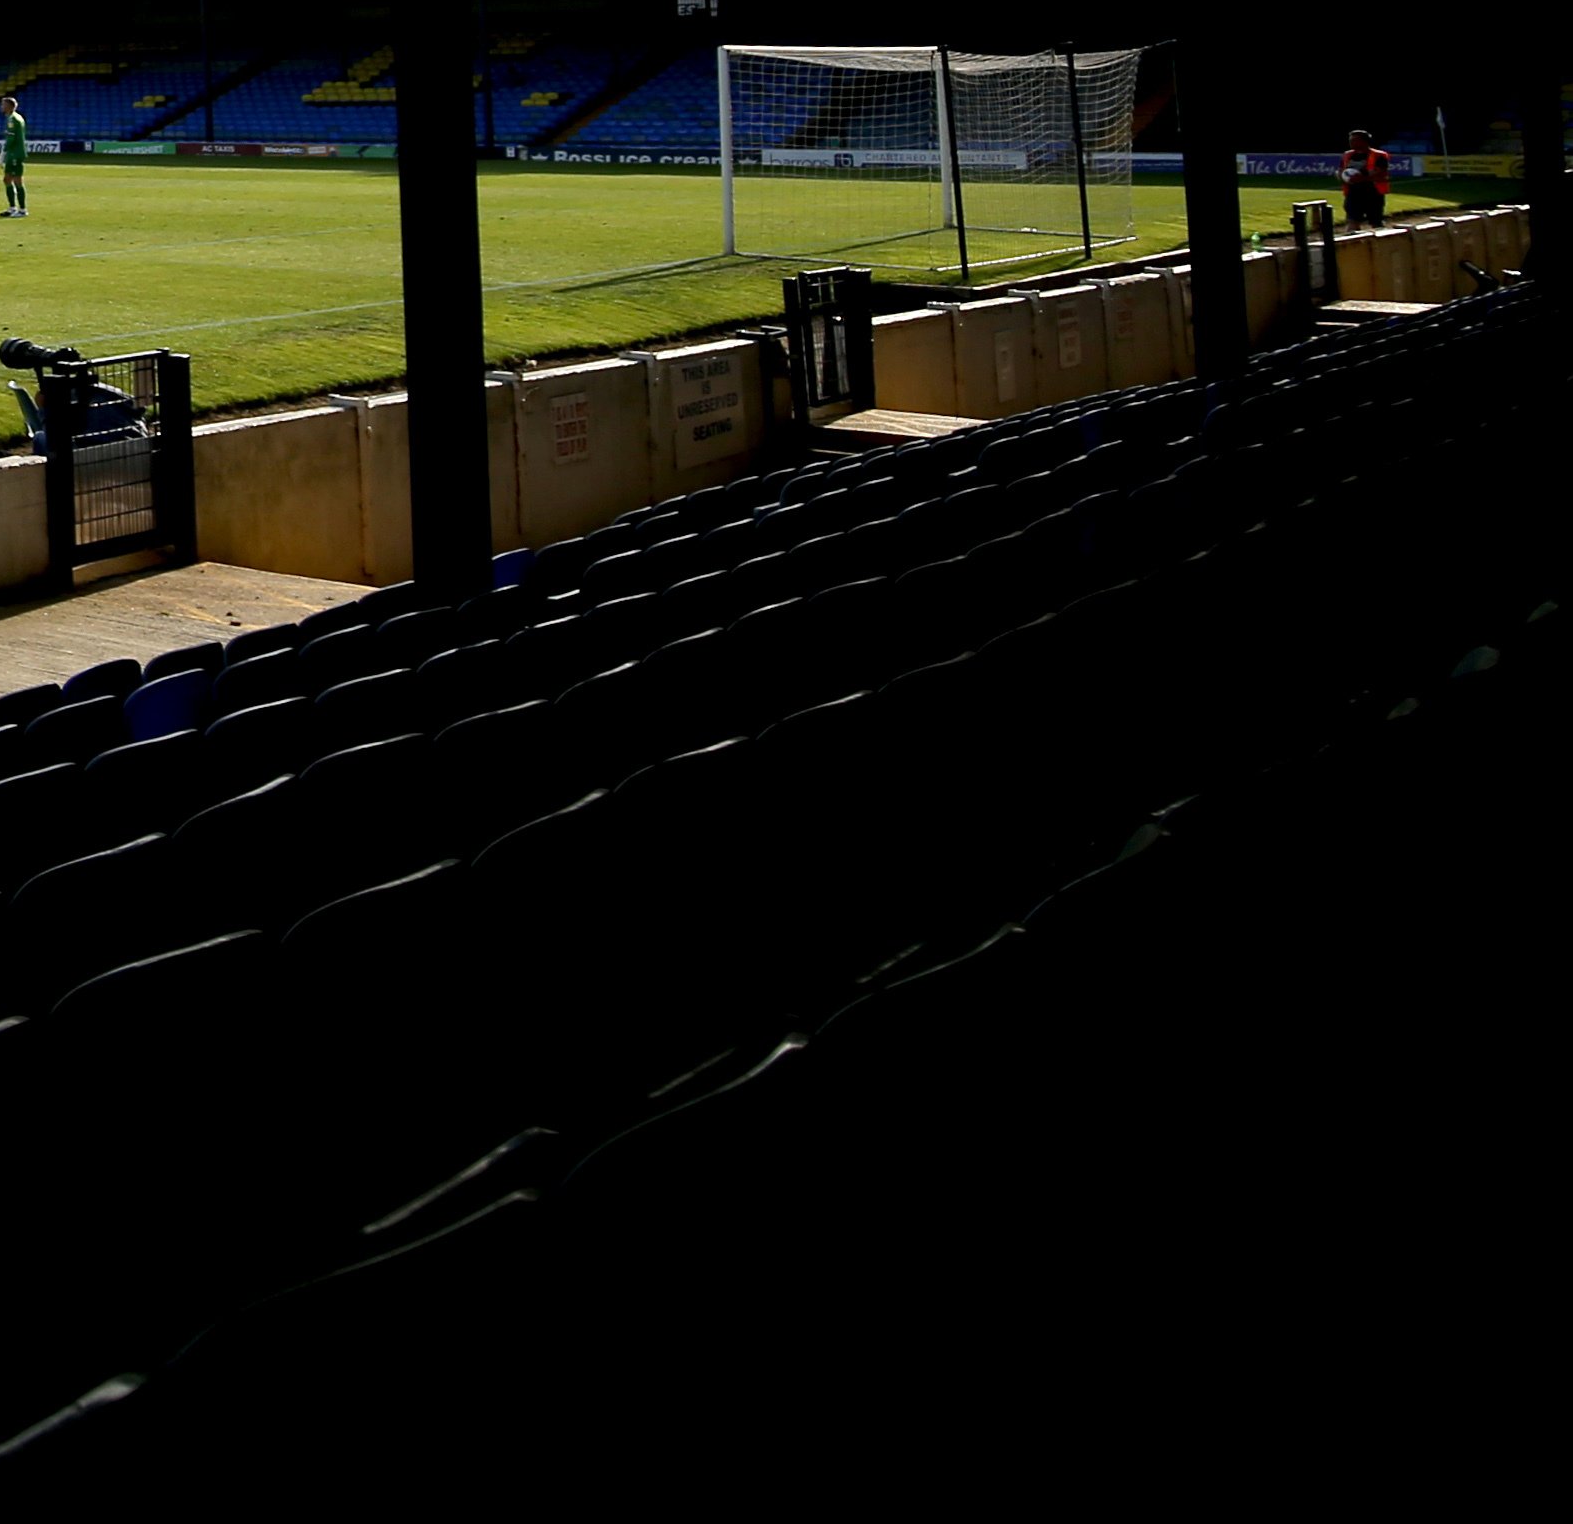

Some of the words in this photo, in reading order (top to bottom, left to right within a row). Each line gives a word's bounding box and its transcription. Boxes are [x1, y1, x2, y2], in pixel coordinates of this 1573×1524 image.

[1247, 160, 1268, 174] The
[681, 365, 704, 383] THIS
[707, 360, 730, 377] AREA
[677, 393, 739, 419] UNRESERVED
[692, 417, 733, 441] SEATING
